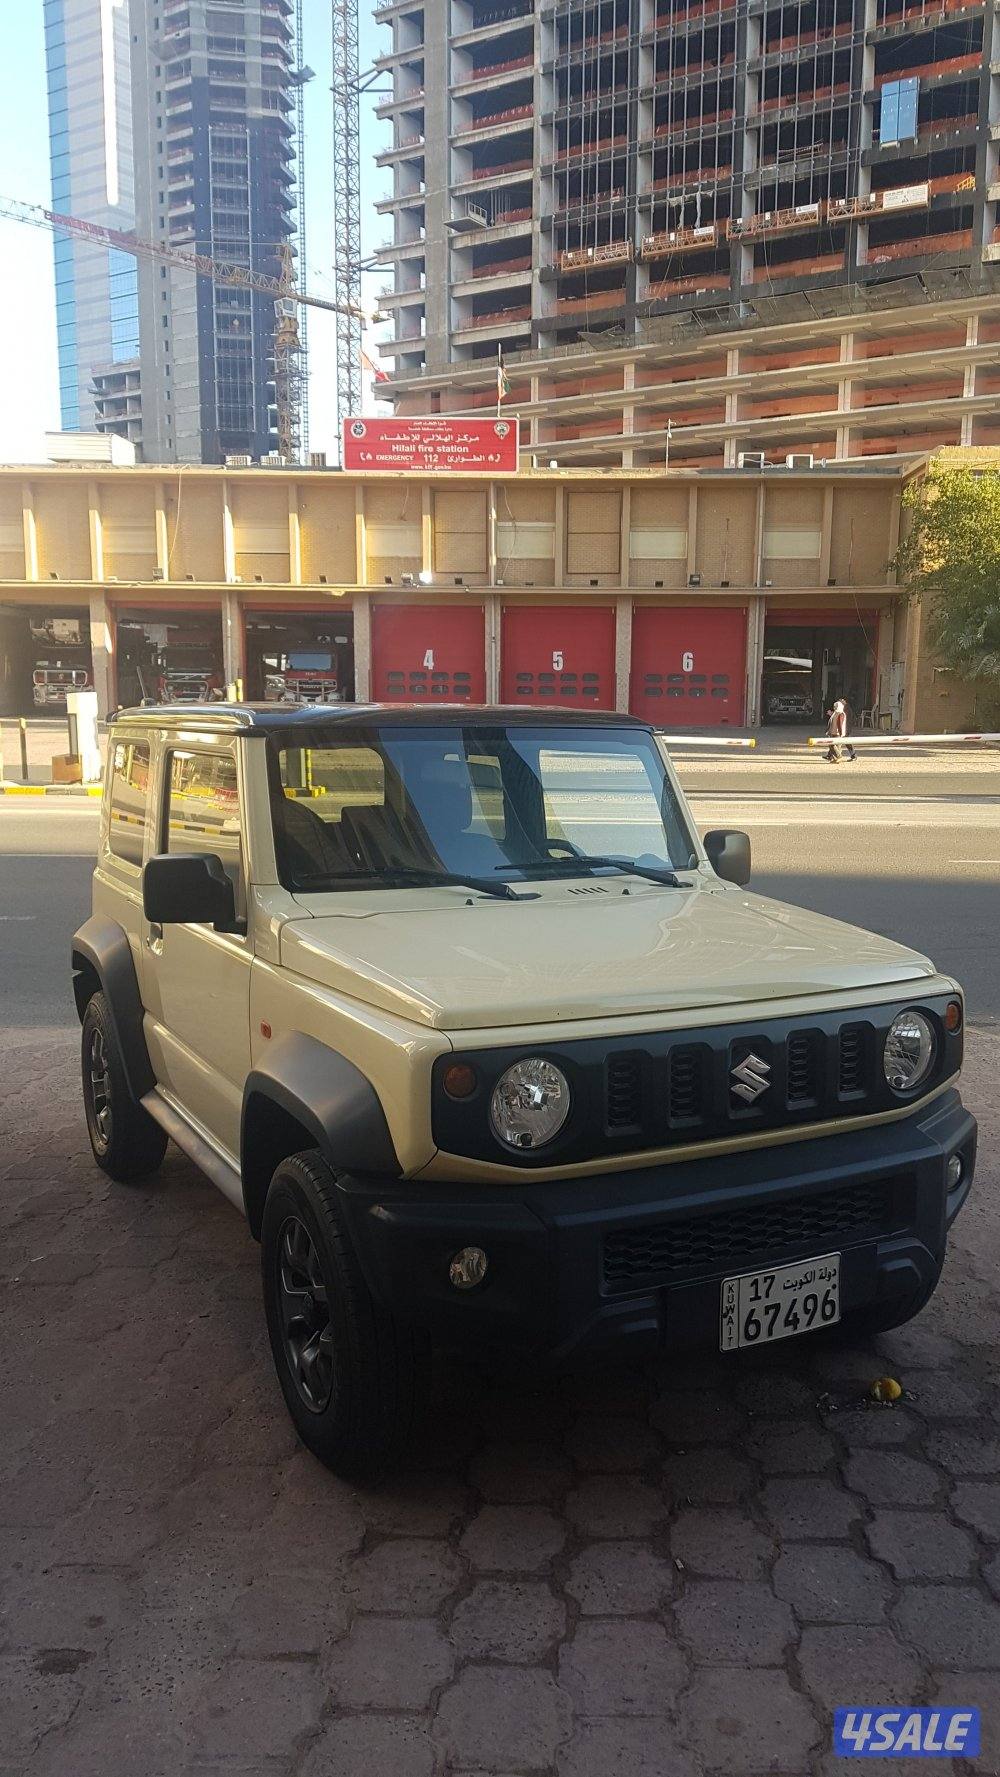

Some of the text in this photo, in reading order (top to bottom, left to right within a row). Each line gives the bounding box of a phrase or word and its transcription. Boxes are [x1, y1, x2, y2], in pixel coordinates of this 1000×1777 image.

[391, 444, 469, 453] Hilali fire station
[455, 434, 480, 443] مركز
[424, 453, 439, 462] 112
[423, 649, 435, 670] 4
[552, 651, 564, 671] 5
[682, 652, 694, 672] 6
[749, 1274, 776, 1302] 17
[782, 1266, 837, 1292] دولة الكويت
[726, 1283, 736, 1347] KUWAIT
[743, 1288, 836, 1341] 67496
